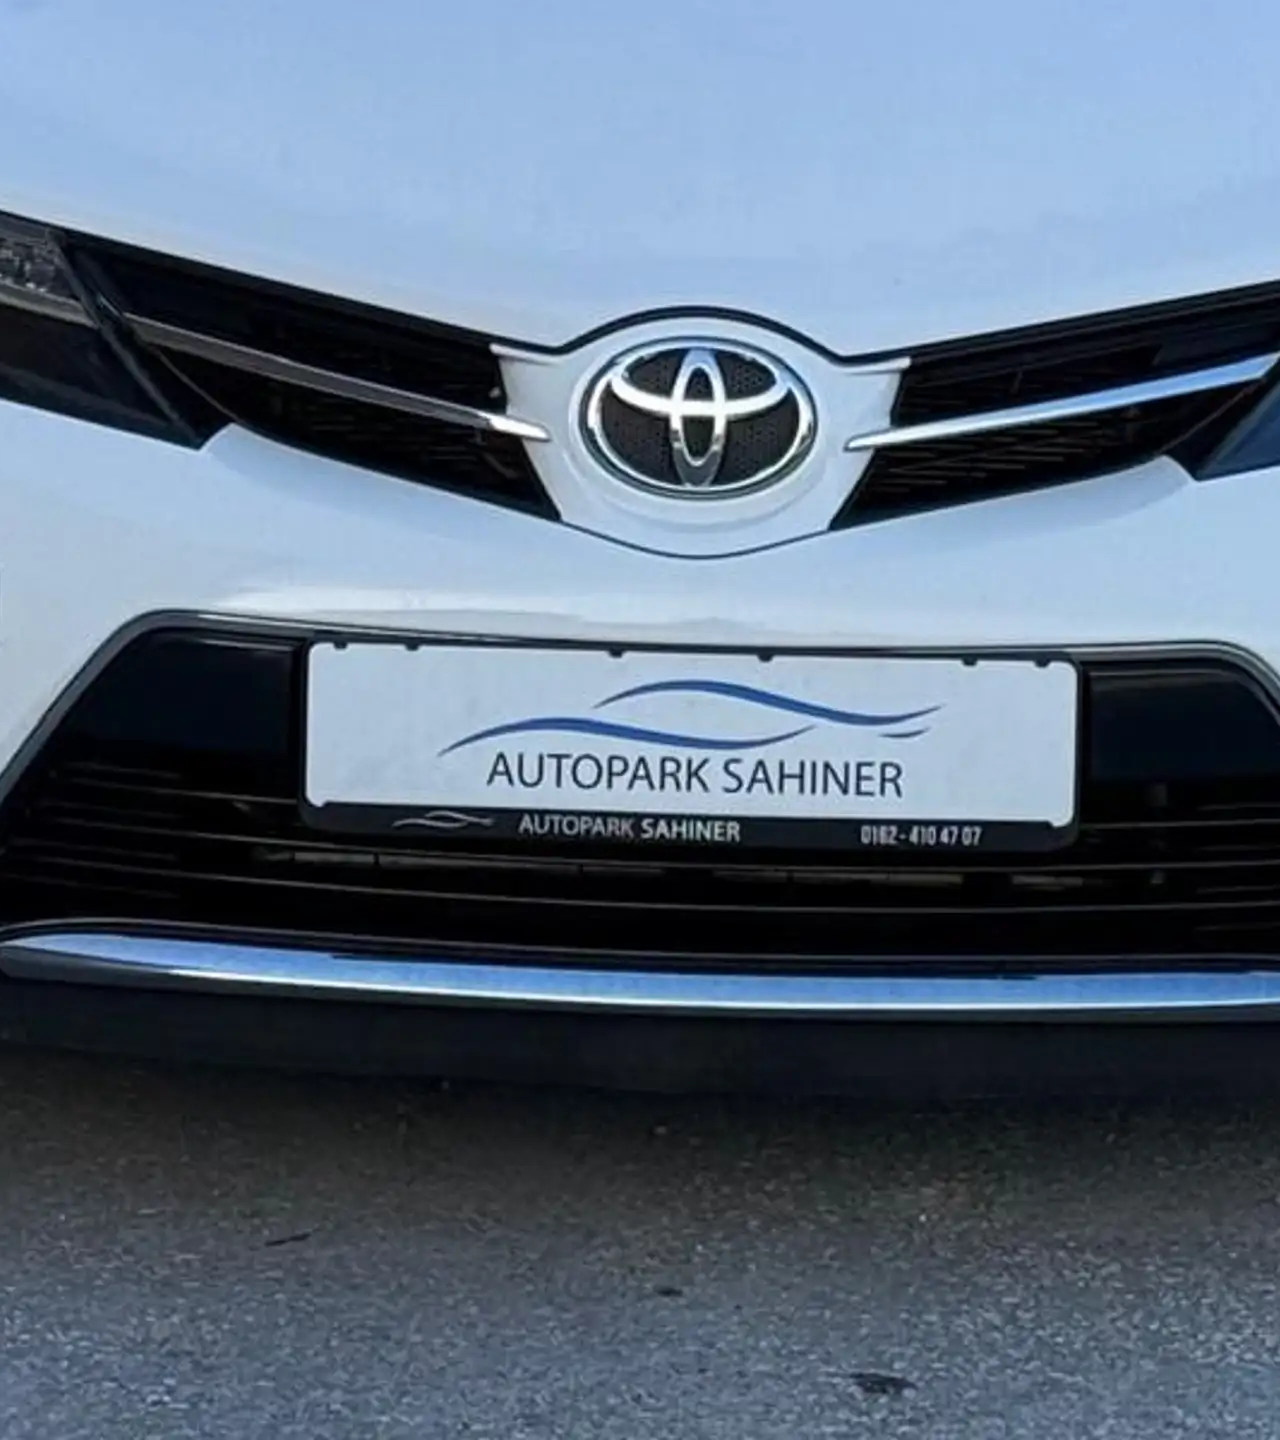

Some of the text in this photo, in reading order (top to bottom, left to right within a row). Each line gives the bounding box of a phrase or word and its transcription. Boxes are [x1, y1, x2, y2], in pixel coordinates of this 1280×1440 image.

[486, 751, 903, 798] AUTOPARK SAHINER
[518, 813, 634, 838] AUTOPARK
[640, 819, 741, 842] SAHINER
